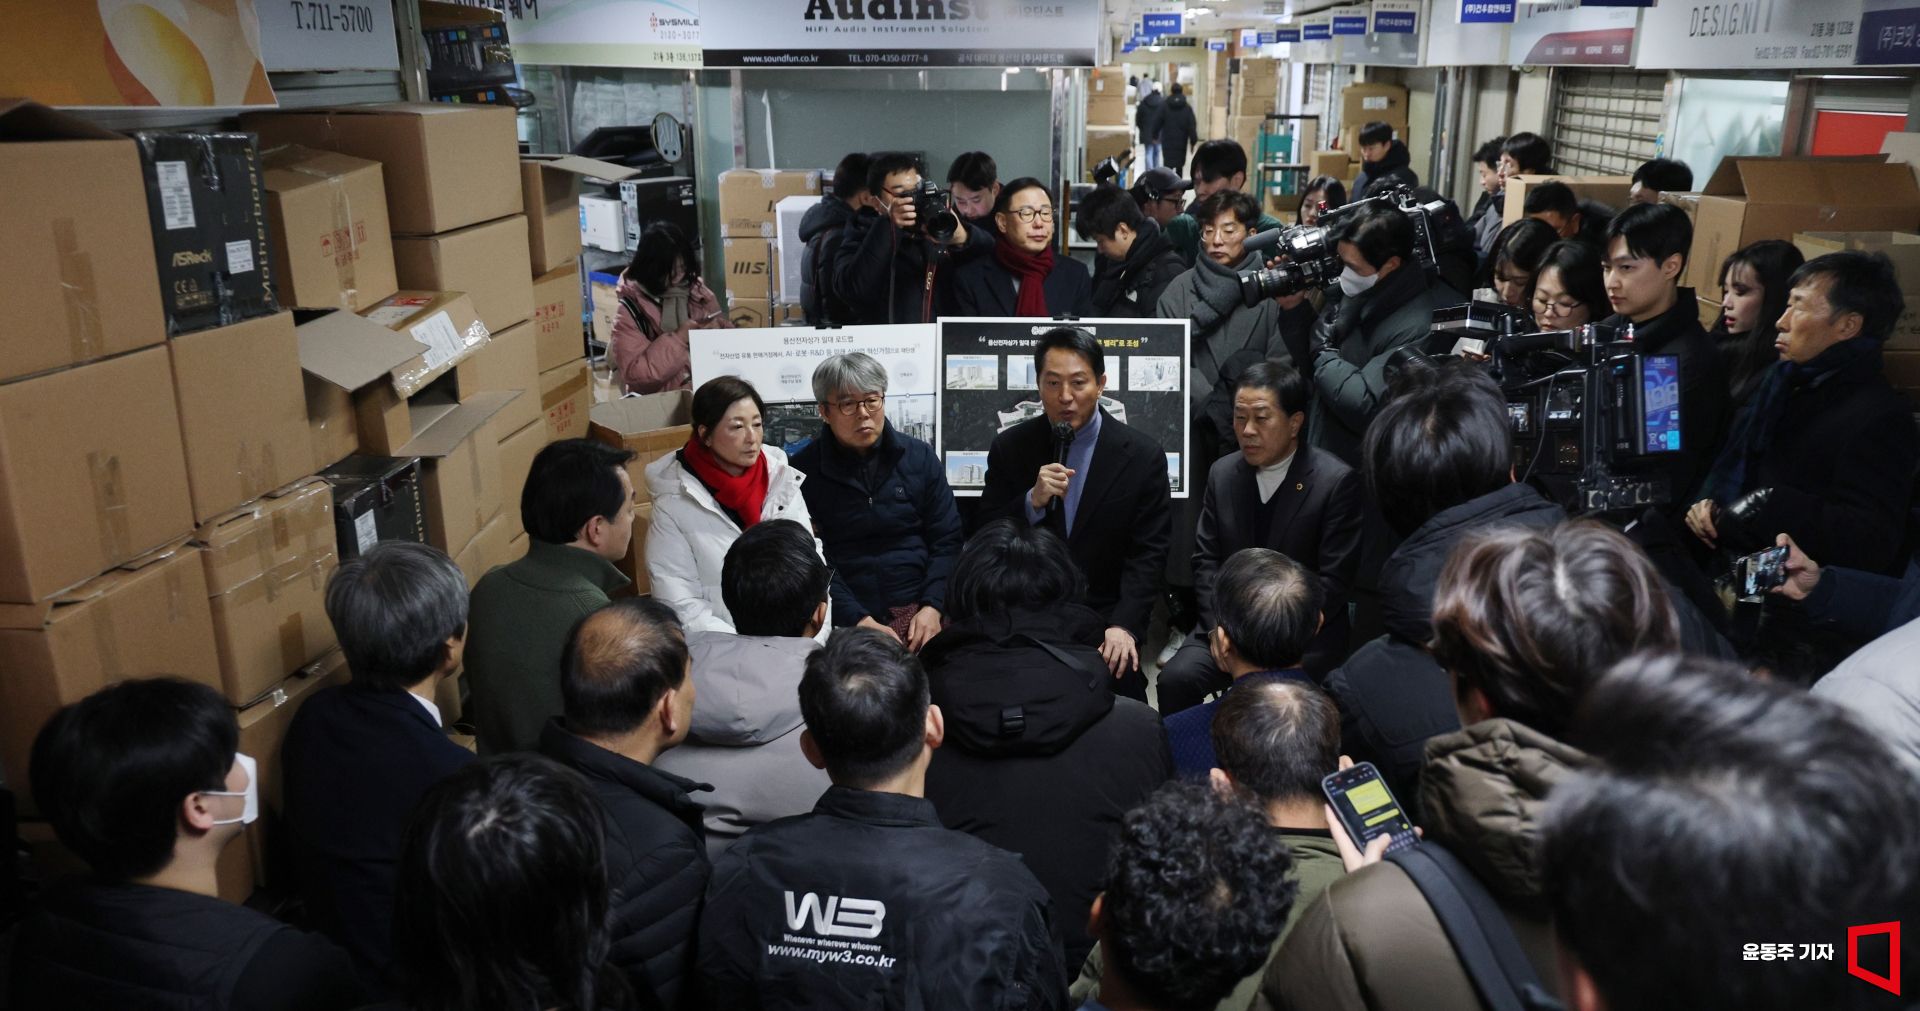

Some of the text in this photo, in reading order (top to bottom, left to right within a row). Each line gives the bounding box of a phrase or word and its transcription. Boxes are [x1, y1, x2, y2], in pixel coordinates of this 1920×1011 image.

[291, 1, 373, 33] T.711-5700
[658, 18, 700, 27] SYSMILE
[805, 25, 989, 33] HiFi Audio Instrument Solution
[742, 54, 818, 63] www.soundfun.co.kr
[848, 55, 864, 63] TEL.
[244, 147, 273, 301] Motherboard
[172, 249, 213, 267] ASRock
[783, 336, 820, 345] 용산전자상가
[821, 336, 834, 344] 일대
[1126, 339, 1139, 347] 조성
[817, 939, 850, 949] wherever
[851, 941, 882, 952] whoever
[768, 944, 897, 968] www.myw3.co.kr
